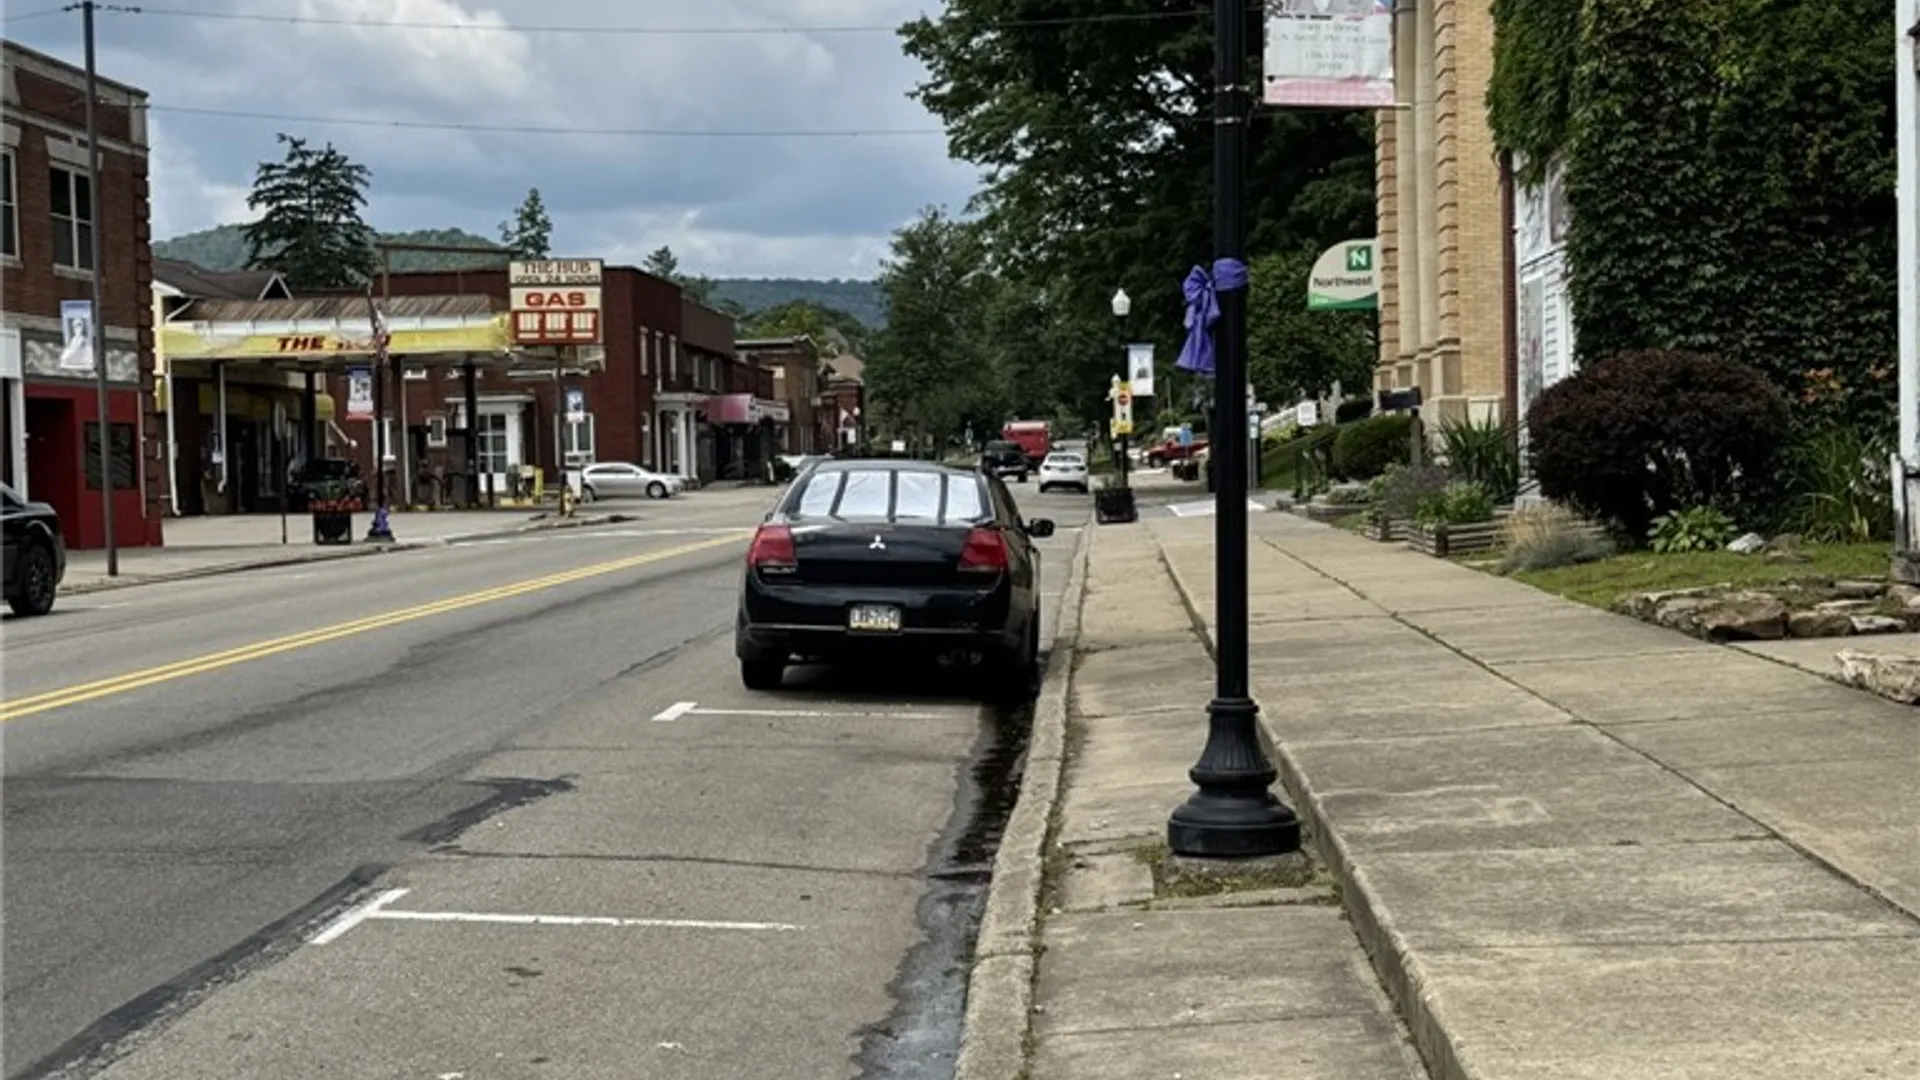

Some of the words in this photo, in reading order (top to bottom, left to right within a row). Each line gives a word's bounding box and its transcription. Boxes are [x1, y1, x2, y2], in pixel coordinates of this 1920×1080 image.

[524, 261, 553, 273] THE
[557, 261, 592, 273] HUB
[515, 275, 541, 283] OPEN
[1313, 276, 1372, 288] Northwest
[525, 292, 586, 306] GAS
[277, 335, 326, 352] THE
